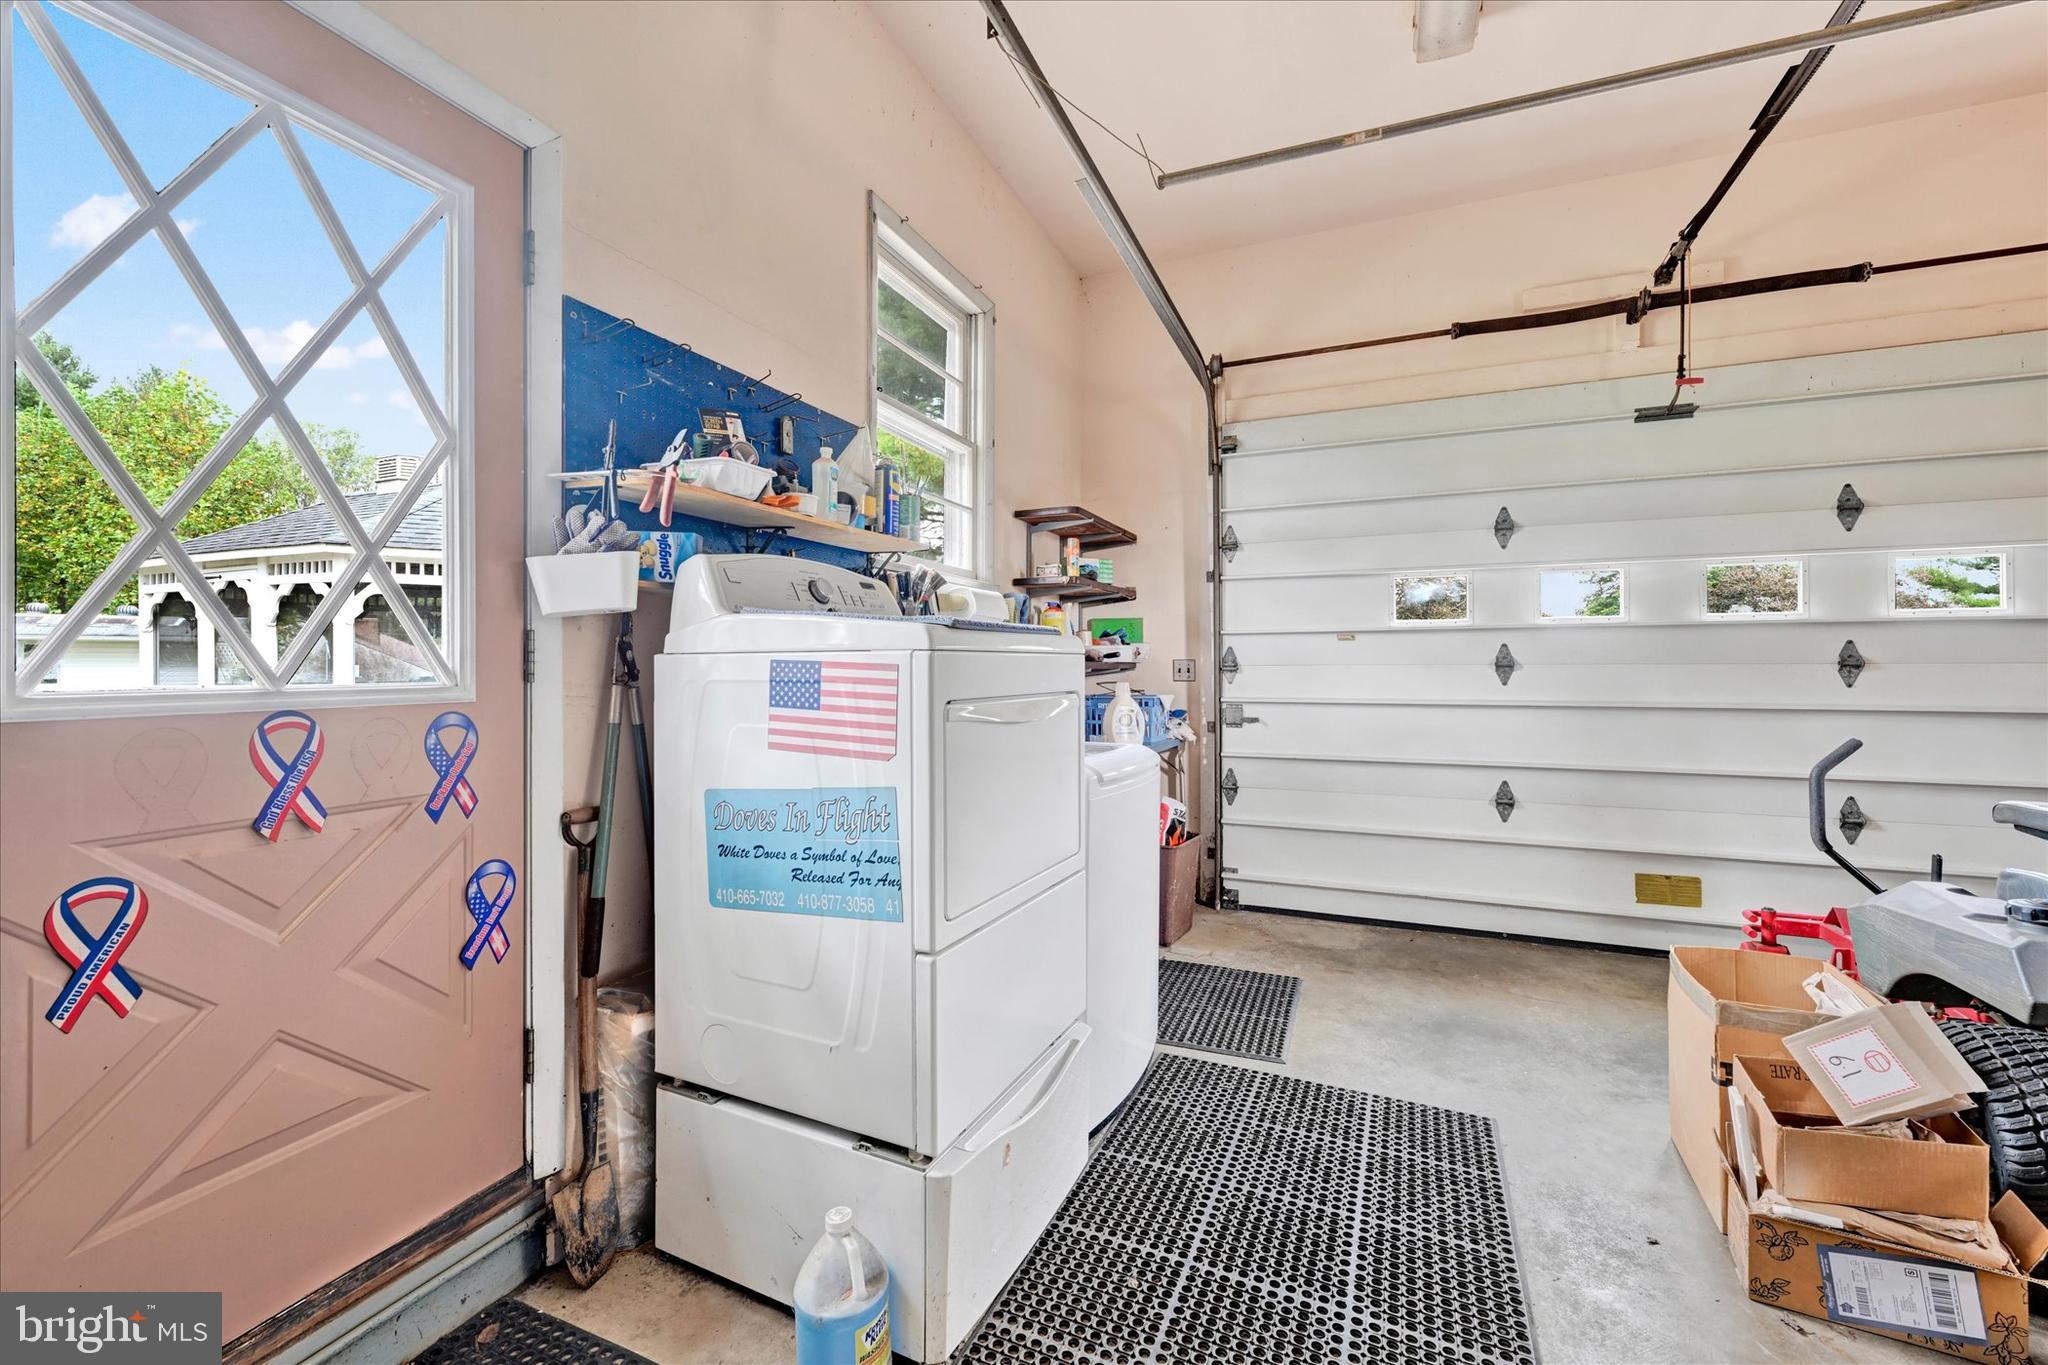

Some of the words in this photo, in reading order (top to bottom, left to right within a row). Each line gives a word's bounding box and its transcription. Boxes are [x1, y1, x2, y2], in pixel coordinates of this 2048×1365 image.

[656, 533, 673, 580] Snuggle
[261, 809, 281, 830] God
[272, 784, 296, 812] Bless
[289, 767, 306, 785] the
[300, 749, 317, 769] USA
[713, 800, 778, 832] Doves
[782, 801, 811, 833] In
[815, 795, 891, 846] Flight
[717, 844, 751, 858] White
[753, 844, 787, 860] Doves
[790, 852, 798, 860] a
[801, 846, 847, 865] Symbol
[850, 850, 863, 868] of
[791, 867, 846, 885] Released
[848, 871, 872, 888] For
[716, 888, 785, 907] 410-665-7032
[797, 893, 875, 914] 410-877-3058
[886, 898, 899, 915] 41
[55, 982, 89, 1021] PROUD
[84, 922, 131, 982] AMERICAN
